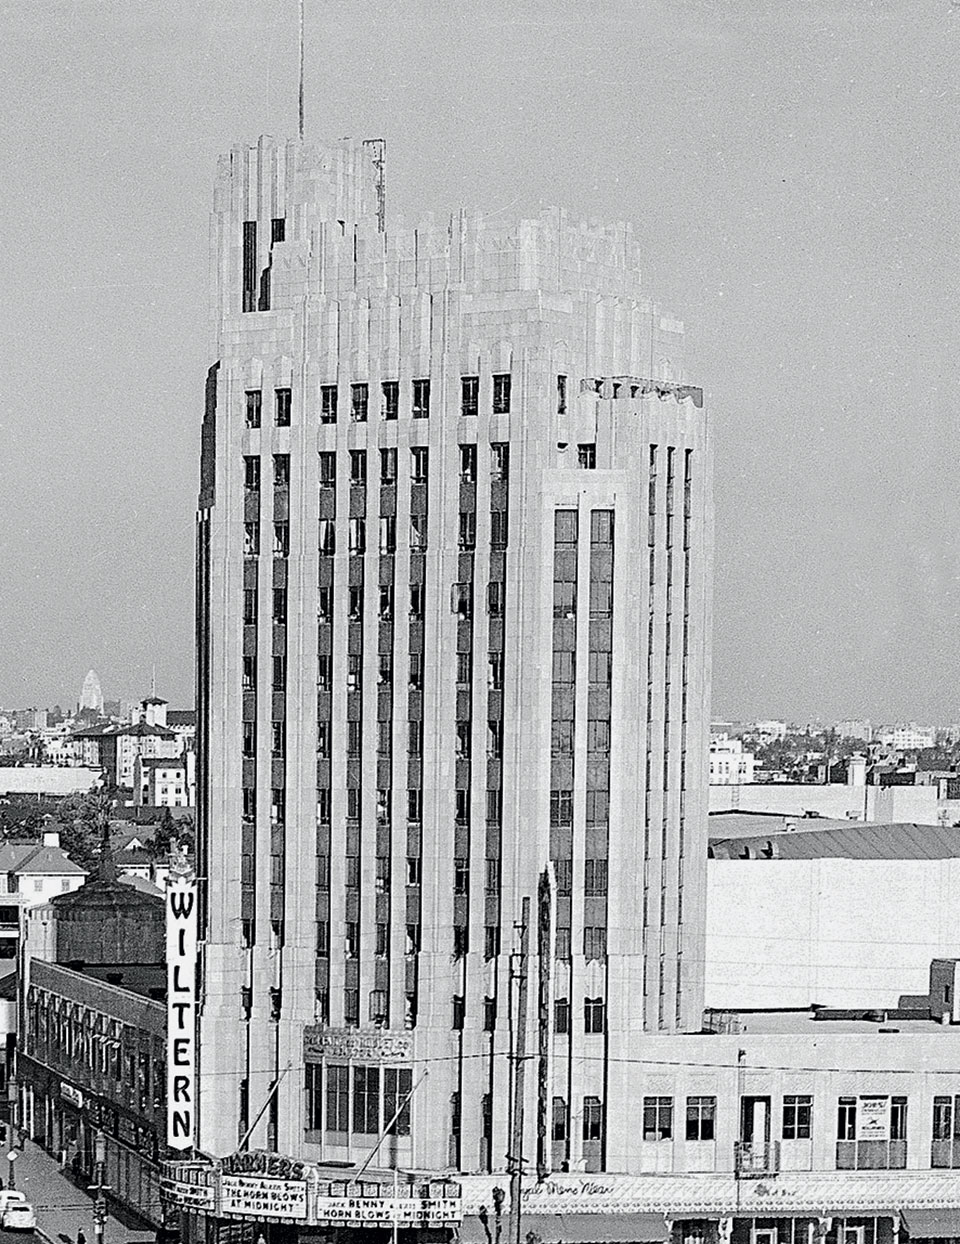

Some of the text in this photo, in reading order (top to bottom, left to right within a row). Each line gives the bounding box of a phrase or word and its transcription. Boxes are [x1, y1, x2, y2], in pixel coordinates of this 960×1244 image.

[170, 891, 194, 1138] WILTERN
[271, 1191, 305, 1203] BLOWS
[348, 1199, 385, 1208] BENNY
[421, 1199, 456, 1209] SMITH
[403, 1210, 456, 1219] MIDNIGHT
